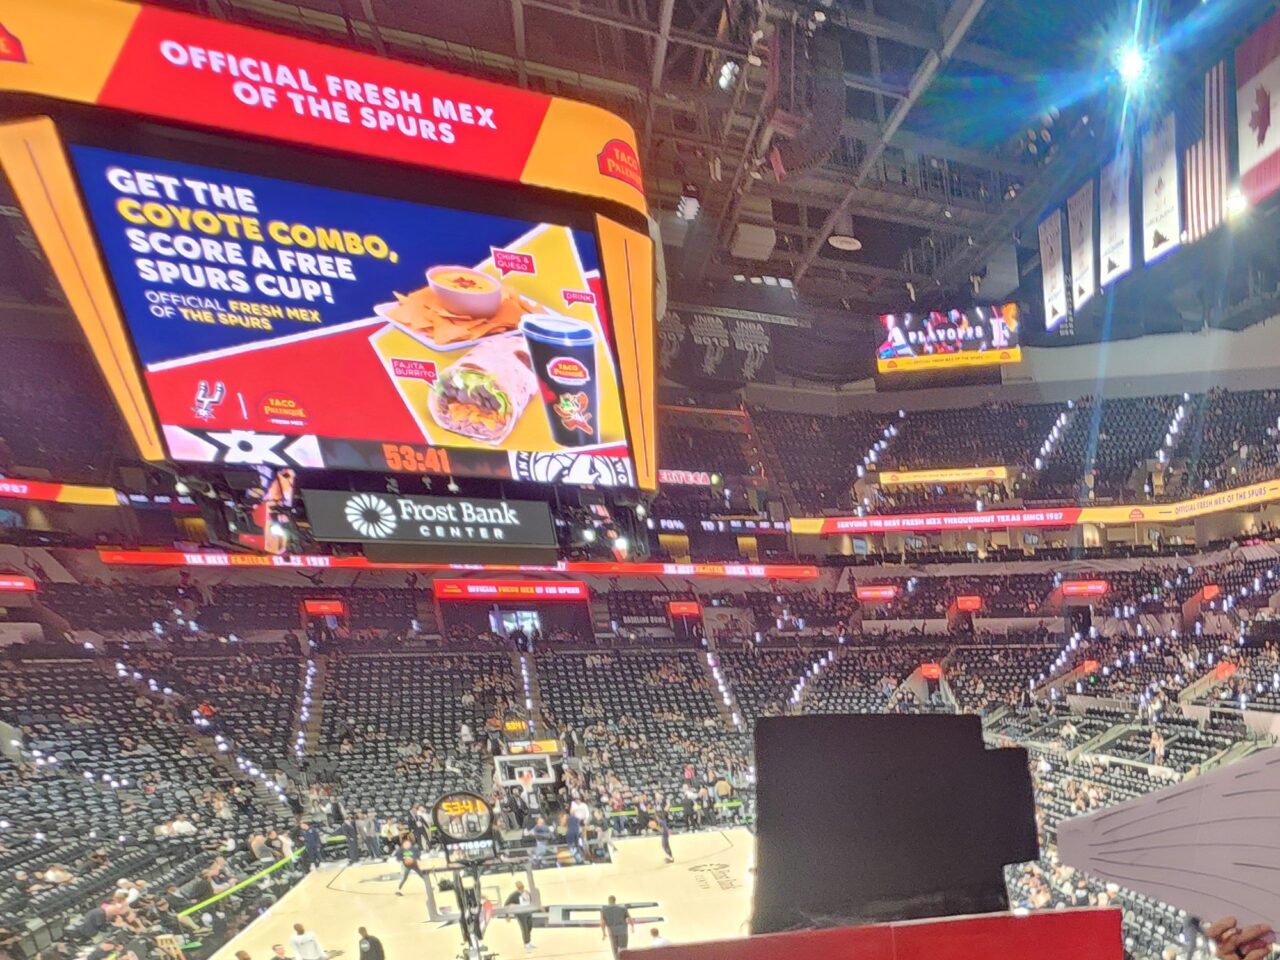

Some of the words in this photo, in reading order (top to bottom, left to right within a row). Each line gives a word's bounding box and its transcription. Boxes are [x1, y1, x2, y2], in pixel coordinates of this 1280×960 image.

[160, 40, 318, 93] OFFICIAL
[326, 74, 422, 114] FRESH
[432, 97, 496, 129] MEX
[233, 81, 278, 109] OF
[287, 92, 350, 124] THE
[360, 106, 455, 144] SPURS
[107, 167, 178, 201] GET
[183, 179, 259, 214] THE
[116, 198, 264, 242] COYOTE
[268, 220, 399, 263] COMBO,
[125, 227, 247, 267] SCORE
[252, 245, 277, 270] A
[278, 248, 356, 281] FREE
[497, 259, 528, 271] QUESO
[136, 258, 250, 294] SPURS
[255, 272, 334, 304] CUP!
[145, 290, 227, 312] OFFICIAL
[228, 300, 283, 319] FRESH
[286, 307, 322, 323] MEX
[150, 305, 176, 319] OF
[179, 307, 216, 324] THE
[219, 313, 273, 331] SPURS
[382, 443, 451, 473] 53:41
[398, 498, 458, 523] Frost
[462, 501, 520, 525] Bank
[419, 525, 505, 540] CENTER
